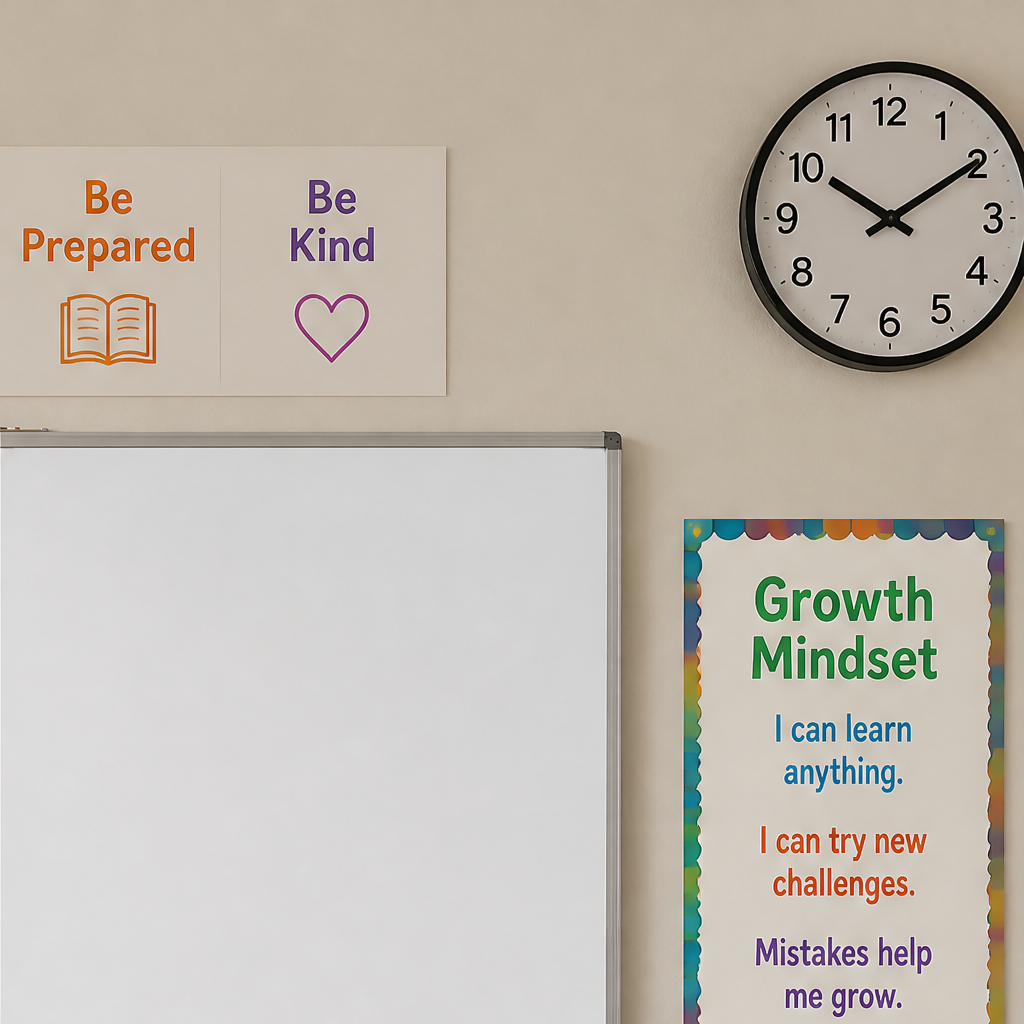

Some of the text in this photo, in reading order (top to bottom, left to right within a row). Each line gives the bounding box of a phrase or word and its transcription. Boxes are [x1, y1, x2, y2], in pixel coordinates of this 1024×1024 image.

[825, 112, 852, 143] 11
[872, 96, 907, 127] 12
[934, 110, 947, 141] 1
[788, 152, 824, 183] 10
[966, 148, 988, 179] 2
[85, 179, 133, 215] Be
[309, 180, 356, 214] Be
[775, 202, 798, 234] 9
[982, 202, 1004, 234] 3
[22, 226, 195, 272] Prepared
[291, 227, 374, 261] Kind
[790, 256, 813, 287] 8
[965, 255, 988, 285] 4
[829, 294, 850, 324] 7
[878, 306, 901, 337] 6
[930, 293, 952, 325] 5
[755, 575, 933, 622] Growth
[752, 635, 937, 680] Mindset
[774, 713, 912, 743] I can learn
[783, 755, 903, 794] anything.
[760, 825, 928, 862] I can try new
[772, 867, 915, 906] challenges.
[756, 936, 932, 974] Mistakes help
[785, 988, 902, 1018] me grow.
